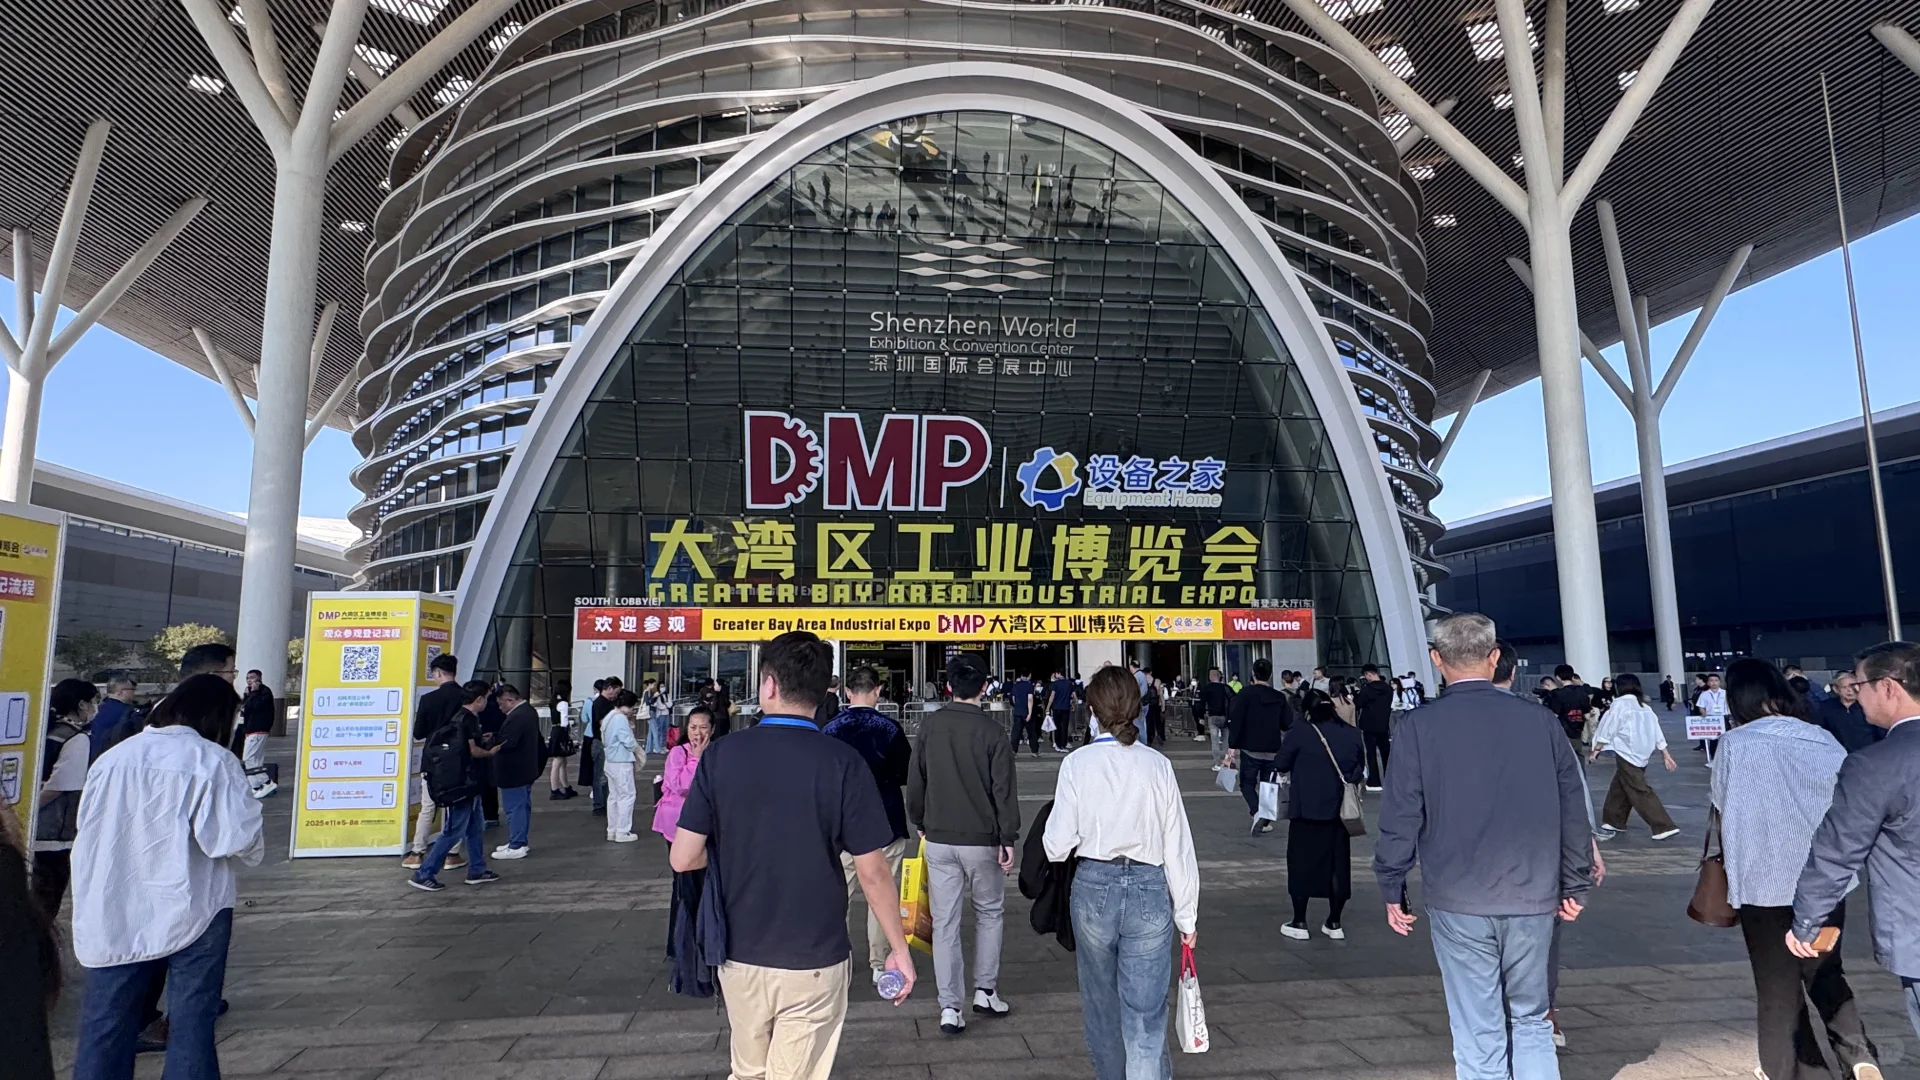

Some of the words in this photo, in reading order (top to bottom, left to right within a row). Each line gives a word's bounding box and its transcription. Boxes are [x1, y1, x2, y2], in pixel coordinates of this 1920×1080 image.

[870, 311, 991, 336] Shenzhen
[1002, 316, 1077, 338] World
[869, 336, 935, 351] Exhibition
[939, 338, 949, 351] &
[953, 339, 1029, 354] Convention
[1031, 342, 1074, 355] Center
[869, 354, 1072, 377] 深圳国际会展中心
[744, 410, 993, 511] DMP
[1088, 454, 1225, 491] 设备之家
[1084, 489, 1170, 509] Equipment
[1171, 492, 1223, 508] Home
[650, 519, 1261, 582] 大湾区工业博览会
[574, 597, 611, 606] SOUTH
[615, 597, 661, 606] LOBBY(E)
[648, 583, 795, 604] GREATER
[811, 583, 874, 604] BAY
[888, 584, 968, 604] AREA
[983, 584, 1166, 604] INDUSTRIAL
[1180, 585, 1258, 605] EXPO
[318, 611, 341, 620] DMP
[594, 615, 686, 633] 欢迎参观
[937, 614, 986, 634] DMP
[989, 614, 1146, 634] 大湾区工业博览会
[1174, 616, 1213, 627] 设备之家
[713, 618, 765, 631] Greater
[768, 618, 792, 633] Bay
[796, 617, 826, 631] Area
[830, 618, 895, 631] Industrial
[900, 618, 931, 632] Expo
[1233, 618, 1301, 631] Welcome
[323, 628, 401, 639] 观众参观登记流程
[317, 695, 331, 708] 01
[314, 726, 330, 739] 02
[312, 758, 327, 770] 03
[310, 789, 325, 802] 04
